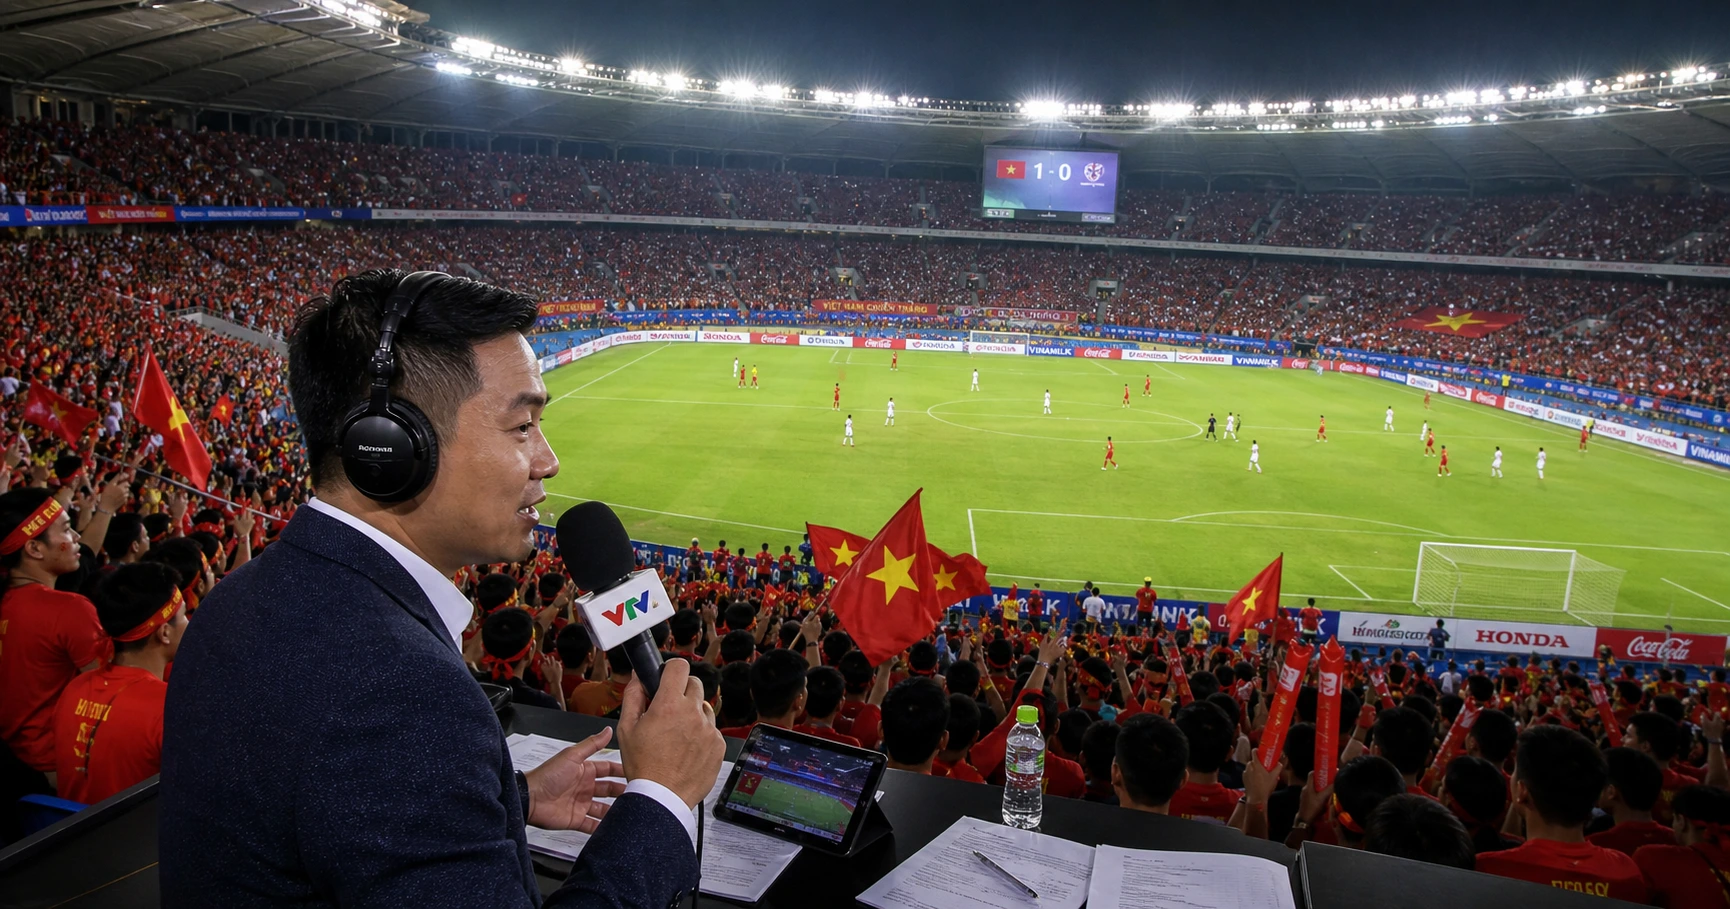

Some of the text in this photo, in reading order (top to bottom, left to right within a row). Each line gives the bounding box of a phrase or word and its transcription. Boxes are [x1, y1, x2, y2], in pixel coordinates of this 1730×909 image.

[1034, 162, 1043, 180] 1
[1058, 163, 1072, 181] 0
[1029, 346, 1072, 356] VINAMILK
[601, 589, 650, 627] VTV
[1475, 629, 1570, 648] HONDA
